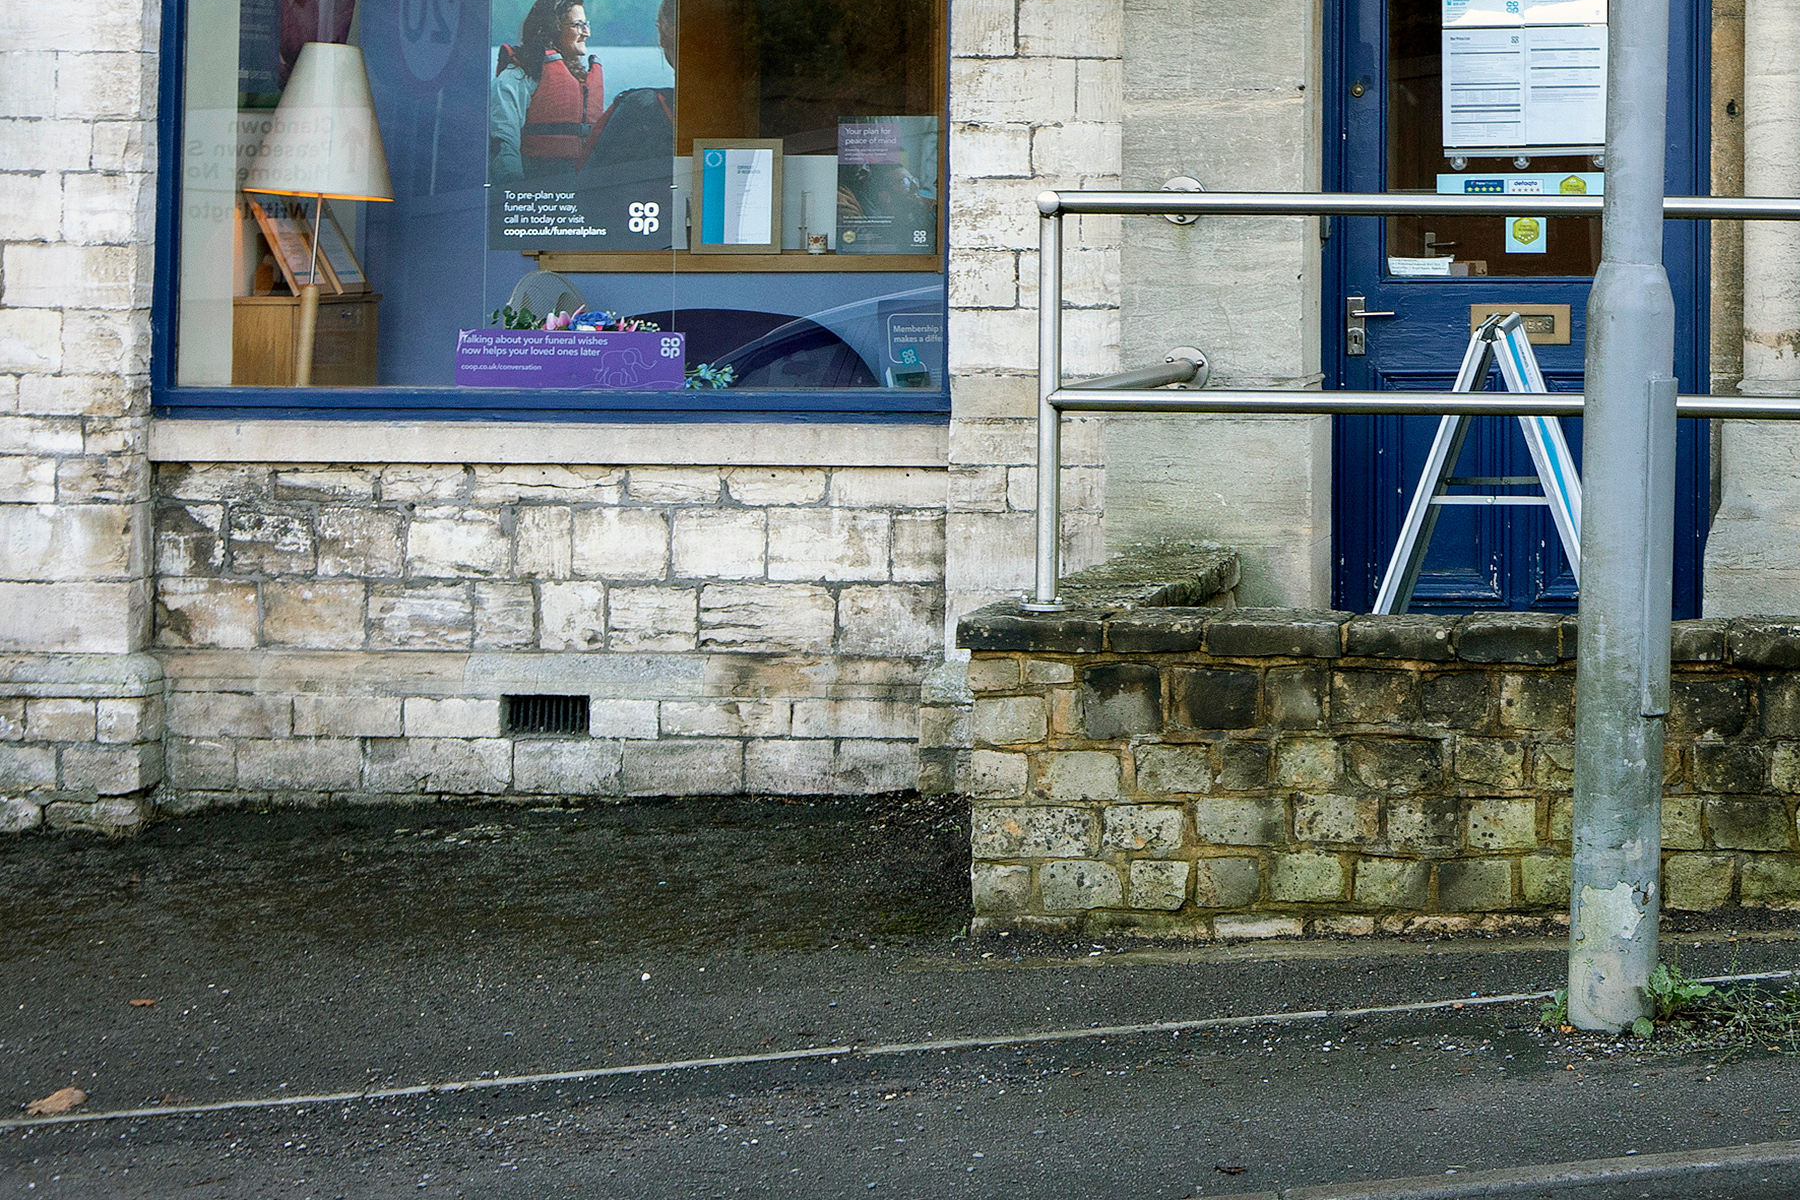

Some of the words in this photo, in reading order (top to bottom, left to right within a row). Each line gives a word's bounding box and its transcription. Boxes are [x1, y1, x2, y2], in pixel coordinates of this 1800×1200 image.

[863, 128, 879, 137] plan
[845, 138, 868, 146] peace
[504, 191, 516, 200] To
[517, 190, 554, 202] pre-plan
[555, 192, 575, 202] your
[504, 202, 536, 213] funeral,
[538, 204, 558, 214] your
[559, 204, 578, 214] way,
[504, 215, 519, 224] call
[521, 215, 529, 224] in
[530, 215, 555, 226] today
[557, 216, 567, 224] or
[568, 215, 585, 224] visit
[504, 227, 607, 238] coop.co.uk/funeralplans
[893, 325, 939, 334] Membership
[462, 334, 493, 346] Talking
[495, 335, 521, 345] about
[523, 337, 544, 347] your
[545, 335, 576, 346] funeral
[578, 335, 608, 346] wishes
[894, 335, 918, 343] makes
[482, 346, 507, 356] helps
[508, 348, 529, 358] your
[530, 346, 556, 356] loved
[580, 348, 600, 357] later
[461, 363, 542, 372] coop.co.uk/conversation
